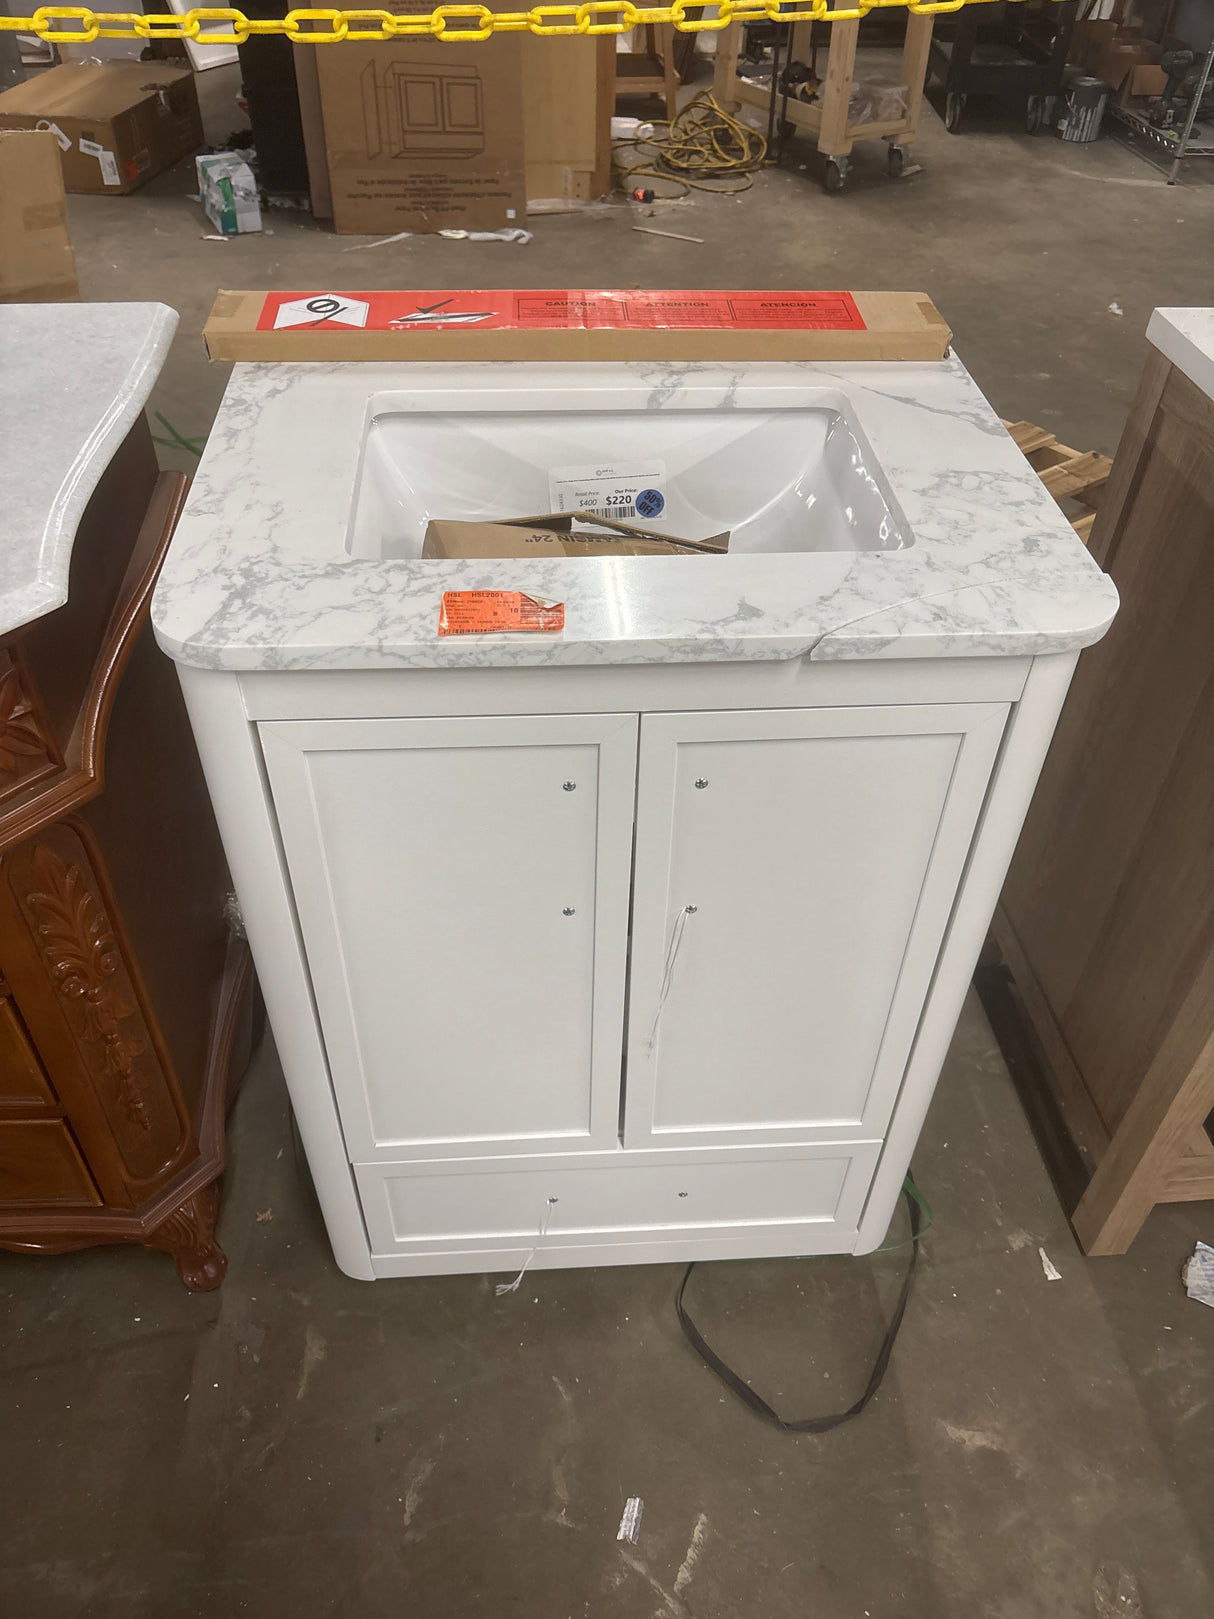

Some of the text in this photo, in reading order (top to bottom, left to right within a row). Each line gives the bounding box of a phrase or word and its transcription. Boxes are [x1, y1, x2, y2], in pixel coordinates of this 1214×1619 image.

[579, 498, 598, 507] $400
[605, 495, 632, 506] $220
[644, 490, 662, 508] 50%
[638, 501, 655, 515] OFF
